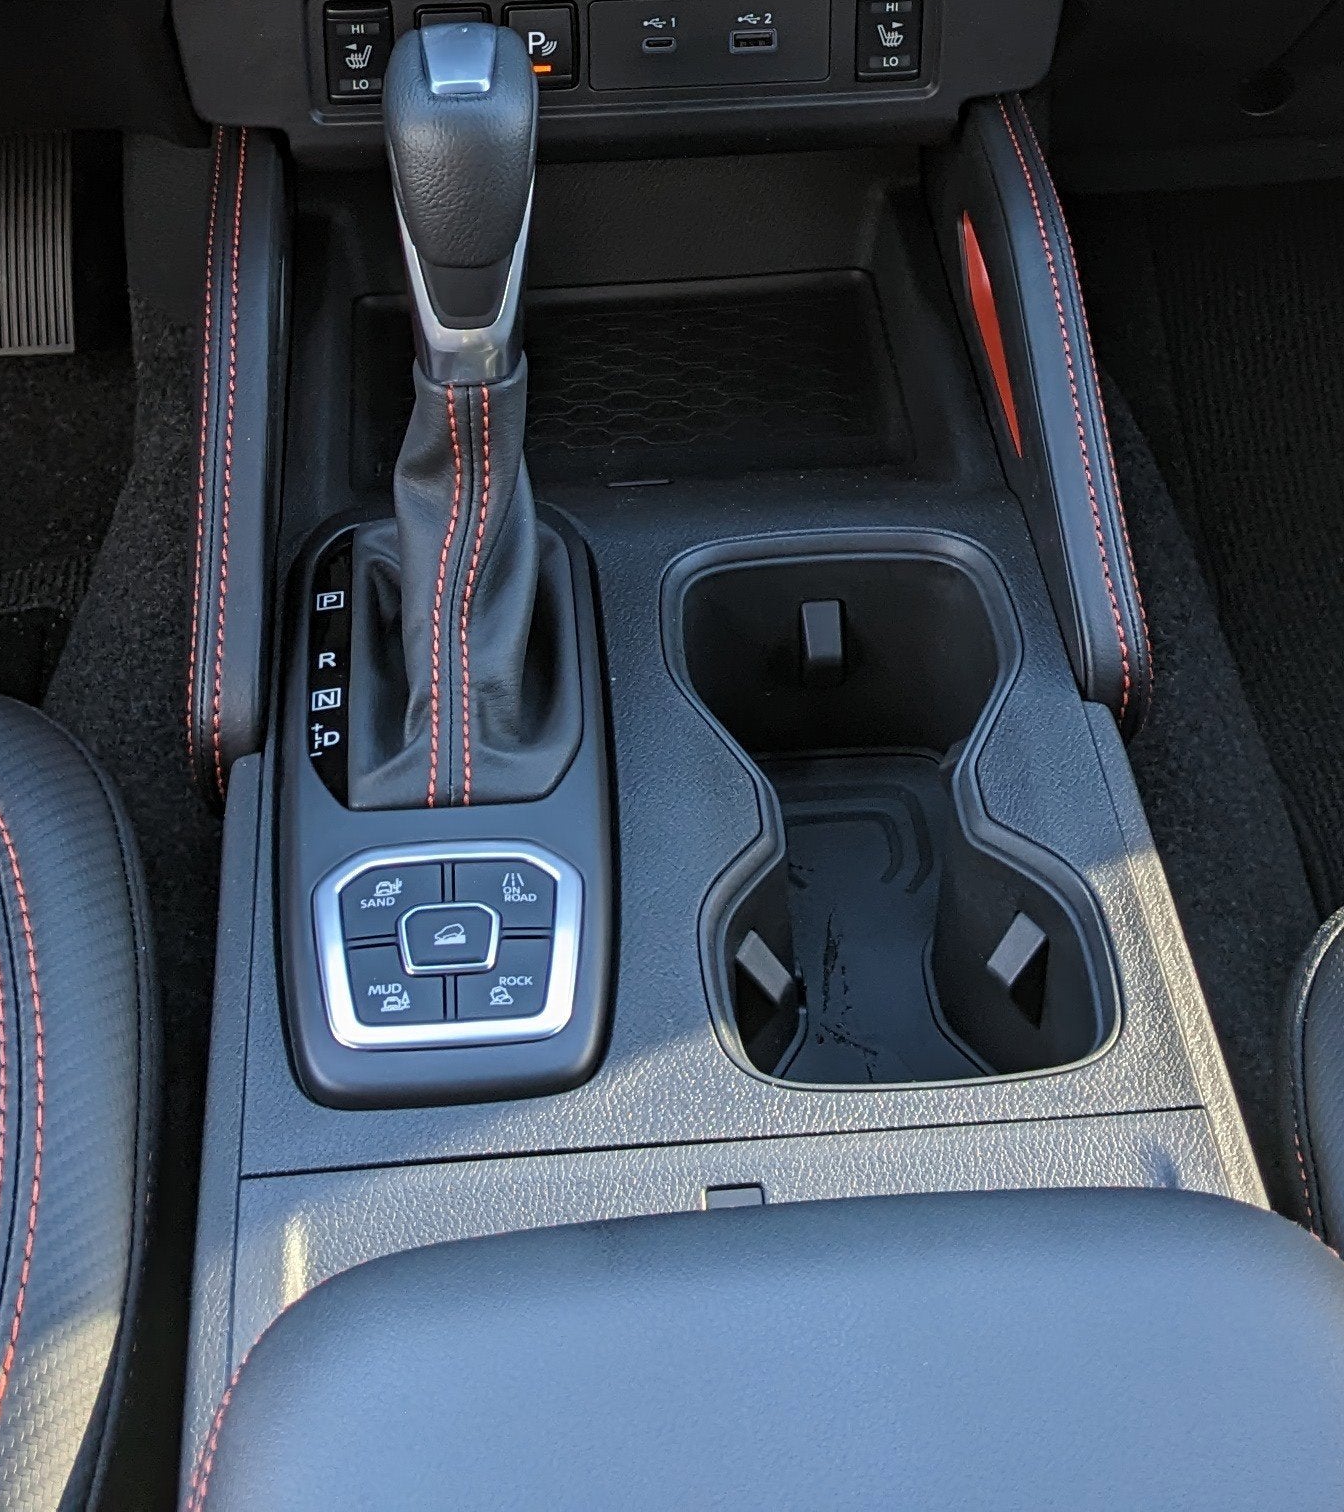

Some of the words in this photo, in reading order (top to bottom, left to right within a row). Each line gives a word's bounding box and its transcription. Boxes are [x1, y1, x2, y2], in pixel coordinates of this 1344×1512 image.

[886, 2, 898, 11] HI
[671, 18, 676, 27] 1
[765, 14, 772, 24] 2
[351, 24, 364, 34] HI
[883, 57, 898, 66] LO
[353, 80, 369, 89] LO
[318, 652, 335, 668] R
[503, 886, 521, 896] ON
[360, 897, 395, 908] SAND
[504, 893, 537, 902] ROAD
[499, 976, 533, 986] ROCK
[368, 984, 402, 996] MUD
